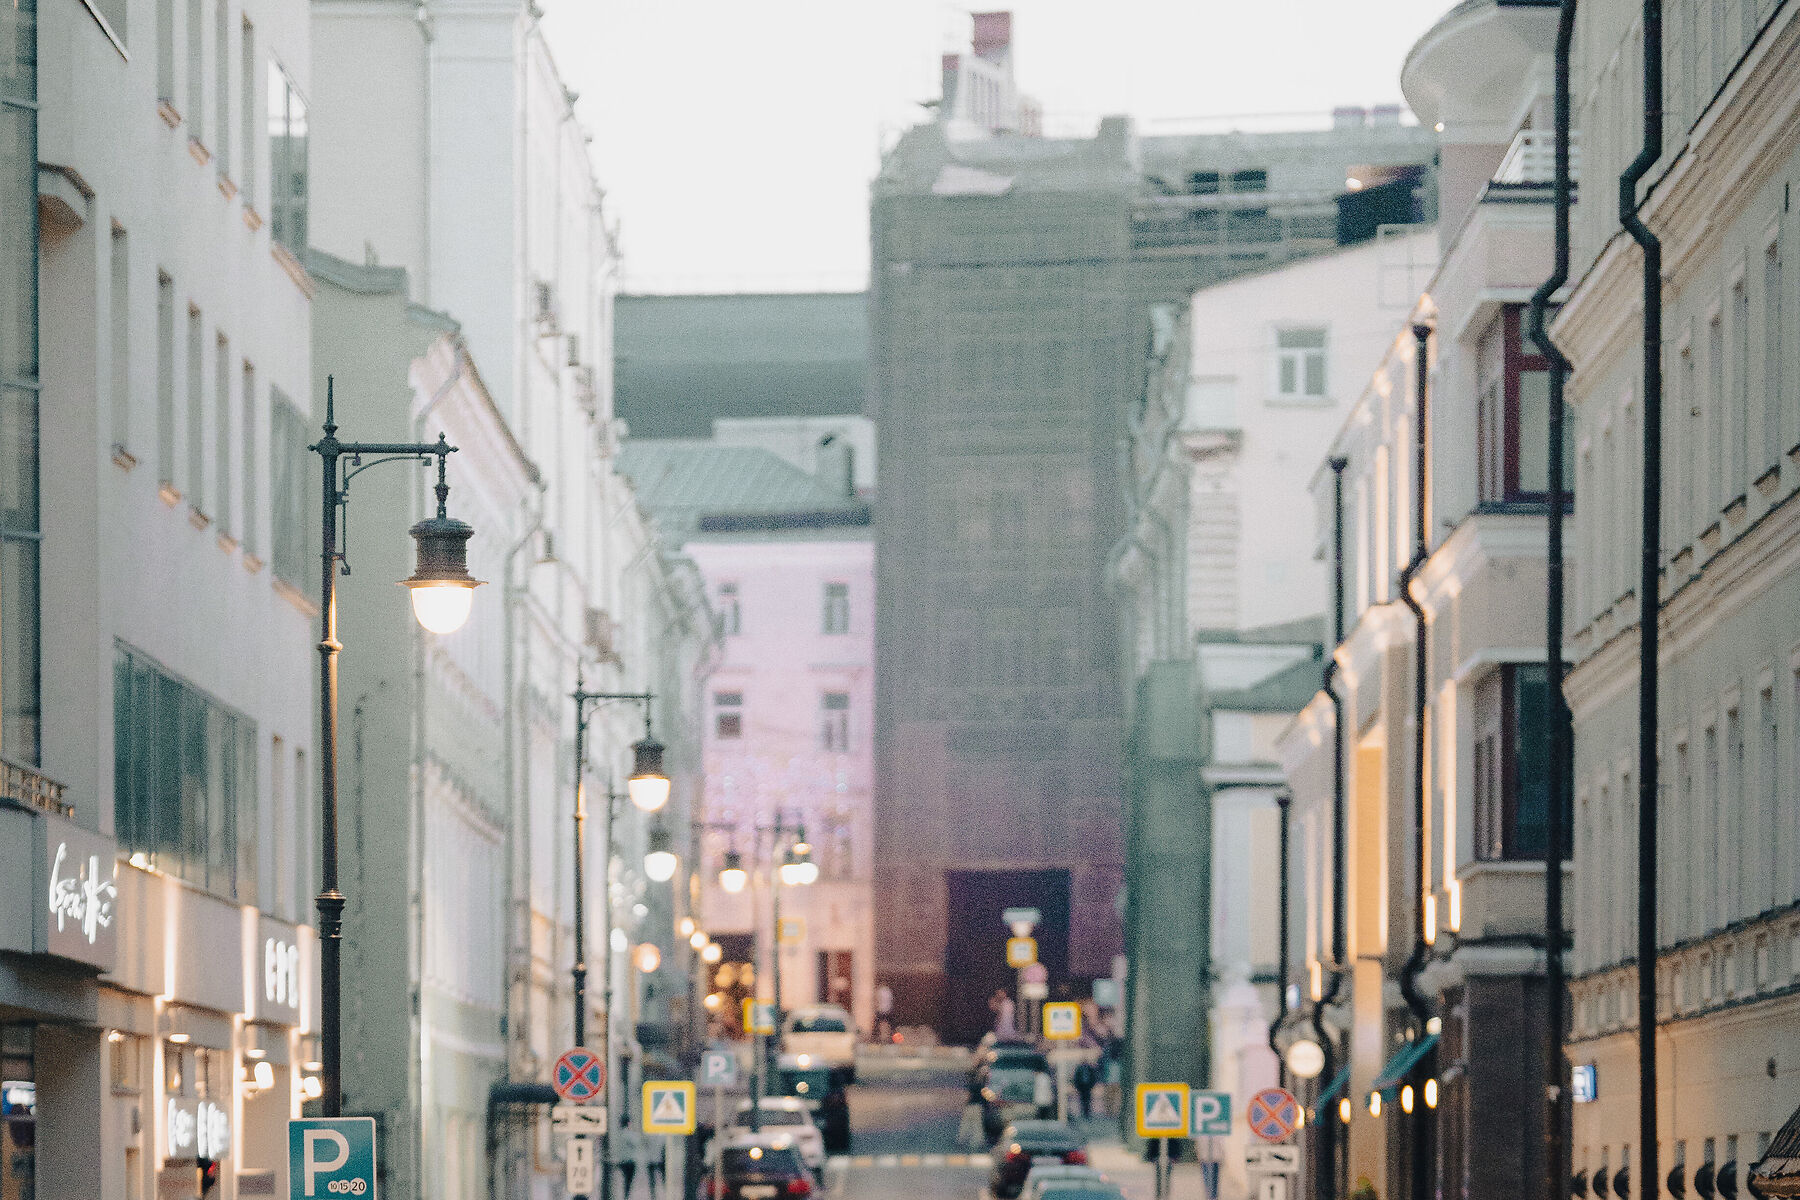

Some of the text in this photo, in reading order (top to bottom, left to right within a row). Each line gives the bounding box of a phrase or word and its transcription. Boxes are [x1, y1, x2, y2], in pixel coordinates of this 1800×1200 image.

[708, 1055, 726, 1078] P
[1195, 1096, 1221, 1132] P
[303, 1129, 350, 1197] P
[340, 1182, 349, 1191] 15
[351, 1181, 366, 1191] 20
